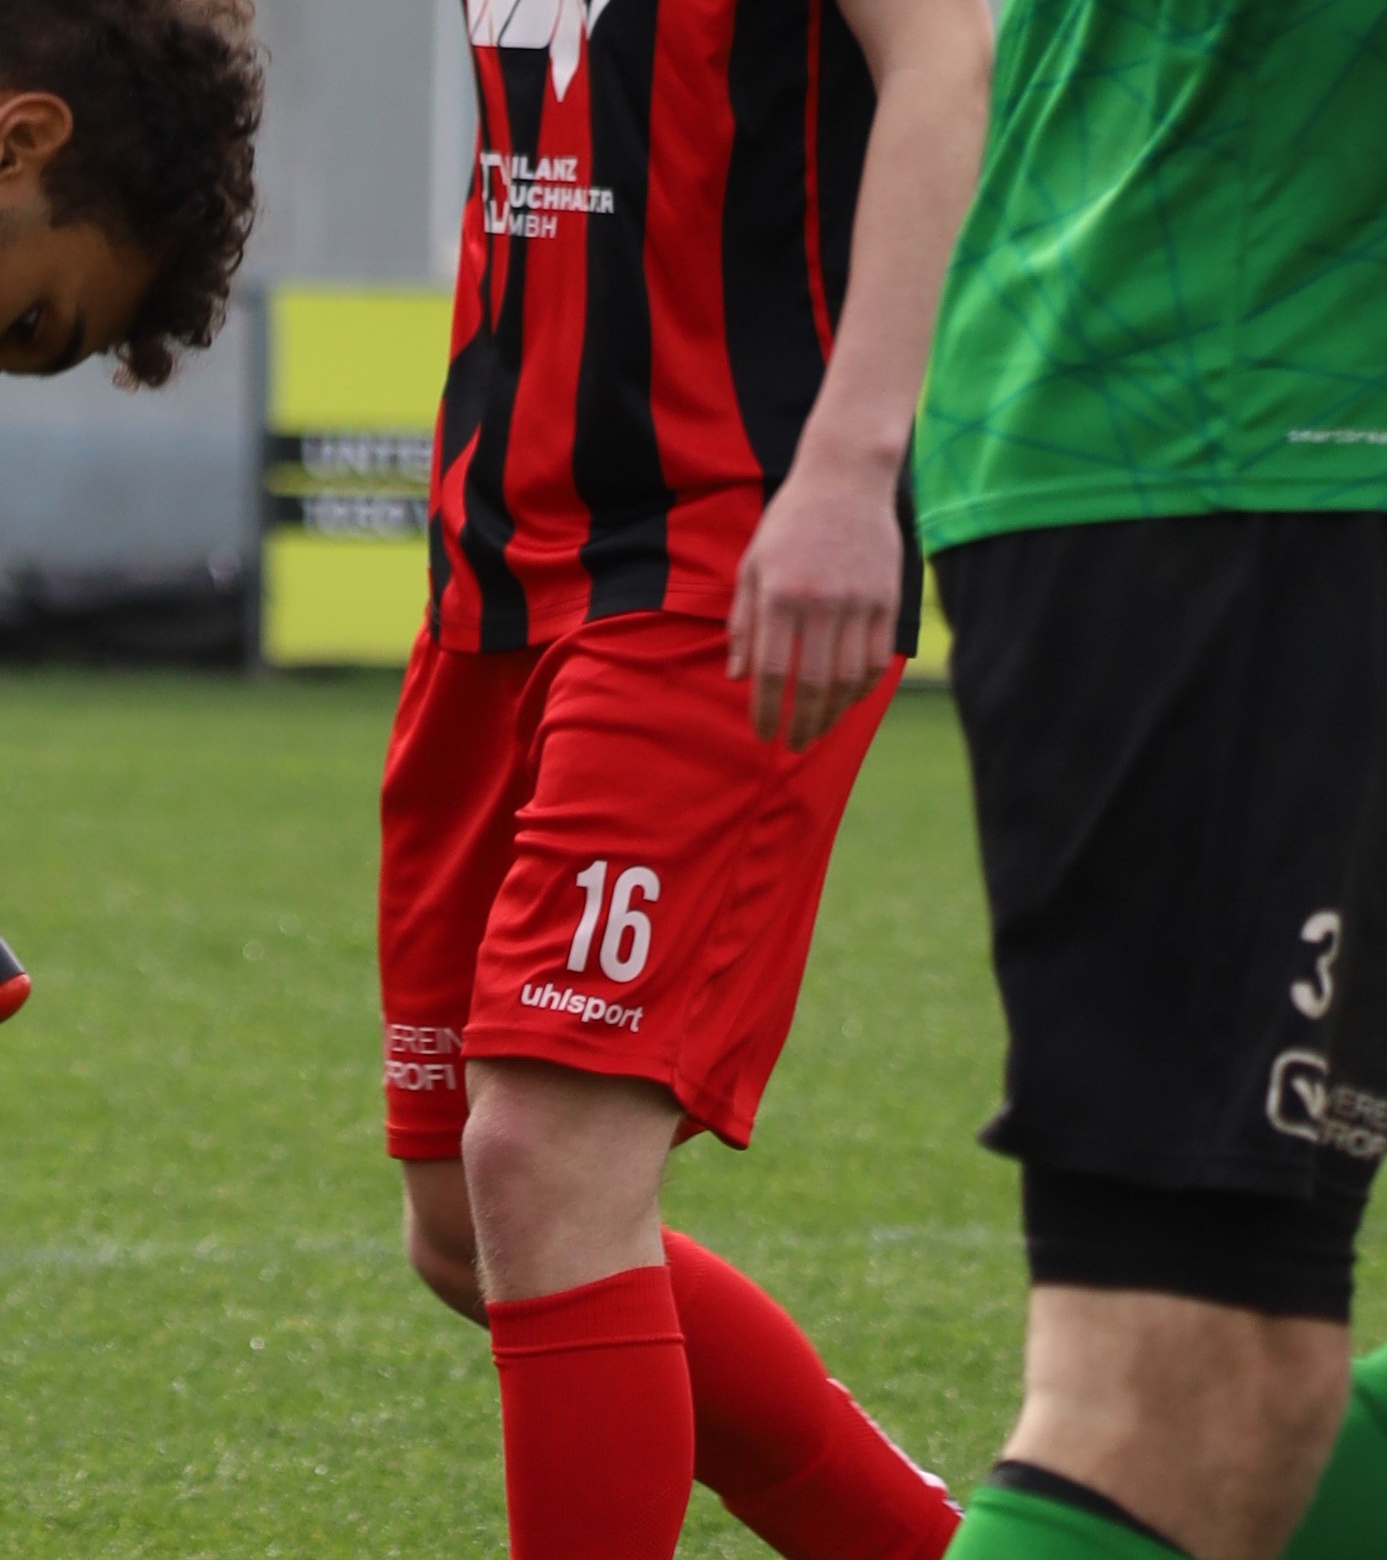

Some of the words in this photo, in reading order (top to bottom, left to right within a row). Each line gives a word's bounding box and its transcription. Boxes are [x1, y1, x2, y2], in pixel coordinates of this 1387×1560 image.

[510, 155, 579, 182] ILANZ
[508, 211, 559, 239] MBH
[565, 859, 661, 984] 16
[519, 982, 644, 1033] uhlsport
[385, 1060, 457, 1091] ROFI
